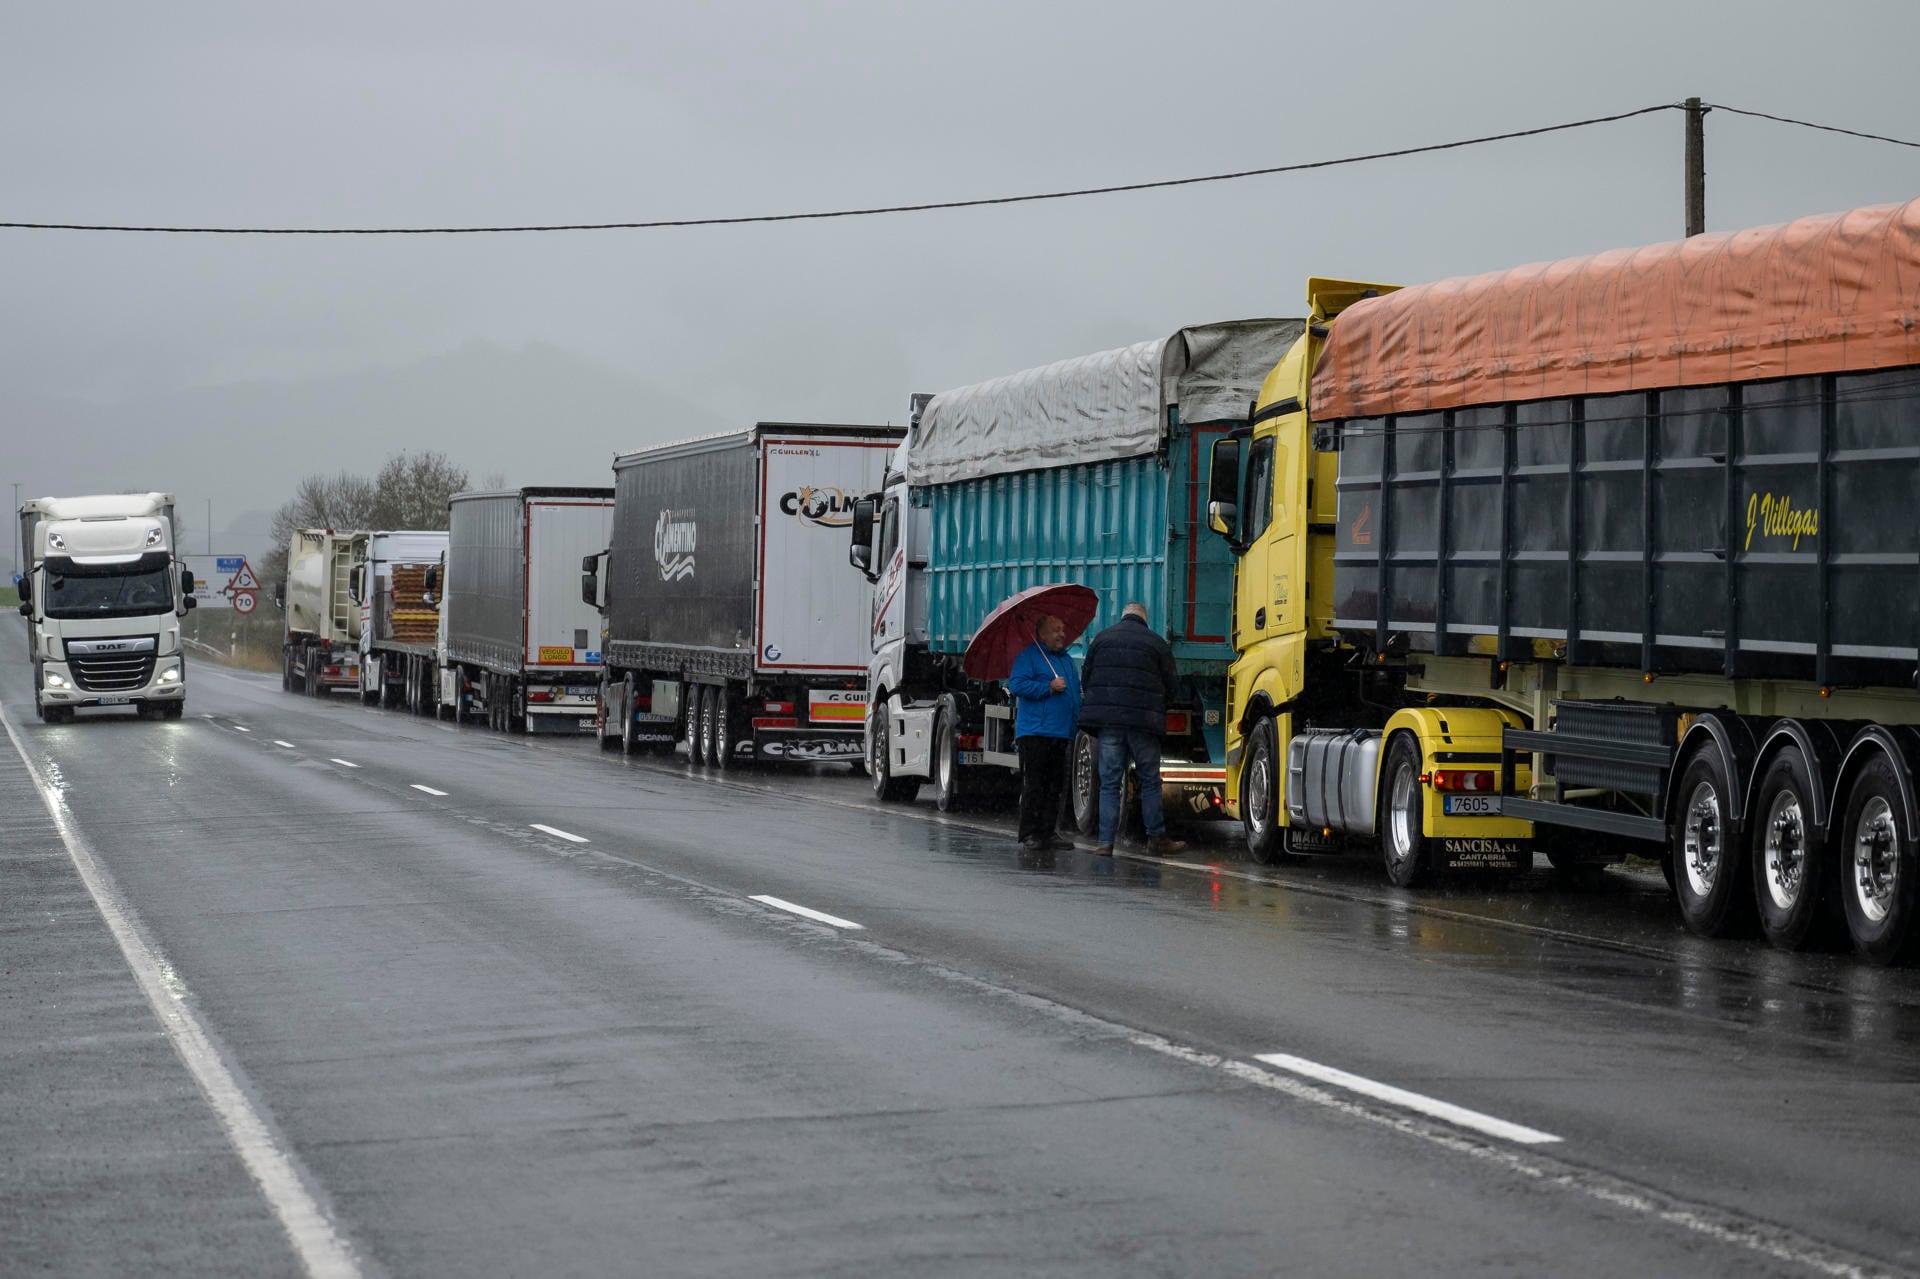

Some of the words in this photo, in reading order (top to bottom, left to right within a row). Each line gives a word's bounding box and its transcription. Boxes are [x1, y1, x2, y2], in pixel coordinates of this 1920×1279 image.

[780, 489, 872, 519] COLM
[1745, 492, 1757, 551] J
[1761, 492, 1819, 551] Villegas
[237, 598, 252, 608] 70
[96, 643, 127, 651] DAF
[579, 694, 597, 702] SCH
[845, 693, 867, 702] GUI
[637, 733, 674, 742] SCANIA
[763, 741, 866, 756] COLM
[967, 754, 984, 763] 161
[1455, 797, 1489, 811] 7605
[1459, 853, 1508, 861] CANTABRIA
